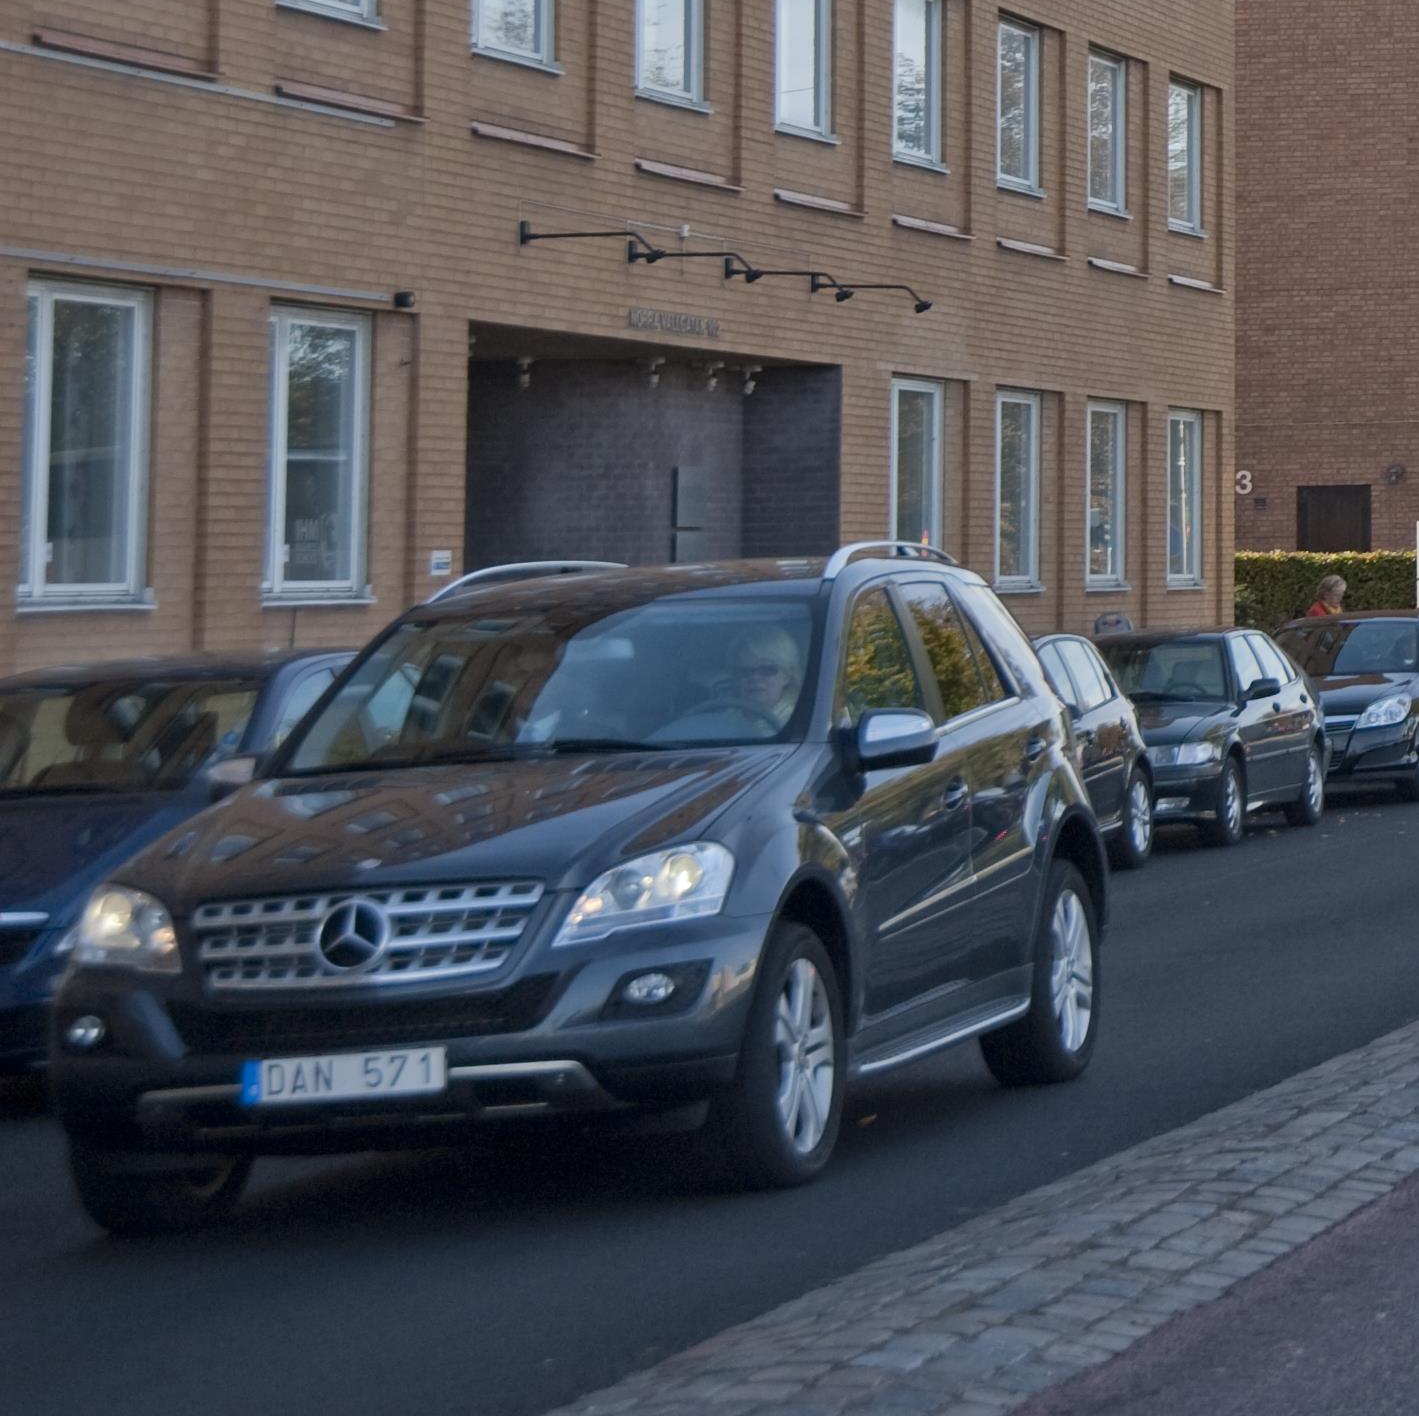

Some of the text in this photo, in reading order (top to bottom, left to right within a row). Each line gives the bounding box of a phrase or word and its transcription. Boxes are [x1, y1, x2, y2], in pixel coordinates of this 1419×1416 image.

[1235, 470, 1253, 495] 3
[266, 1052, 432, 1096] DAN 571
